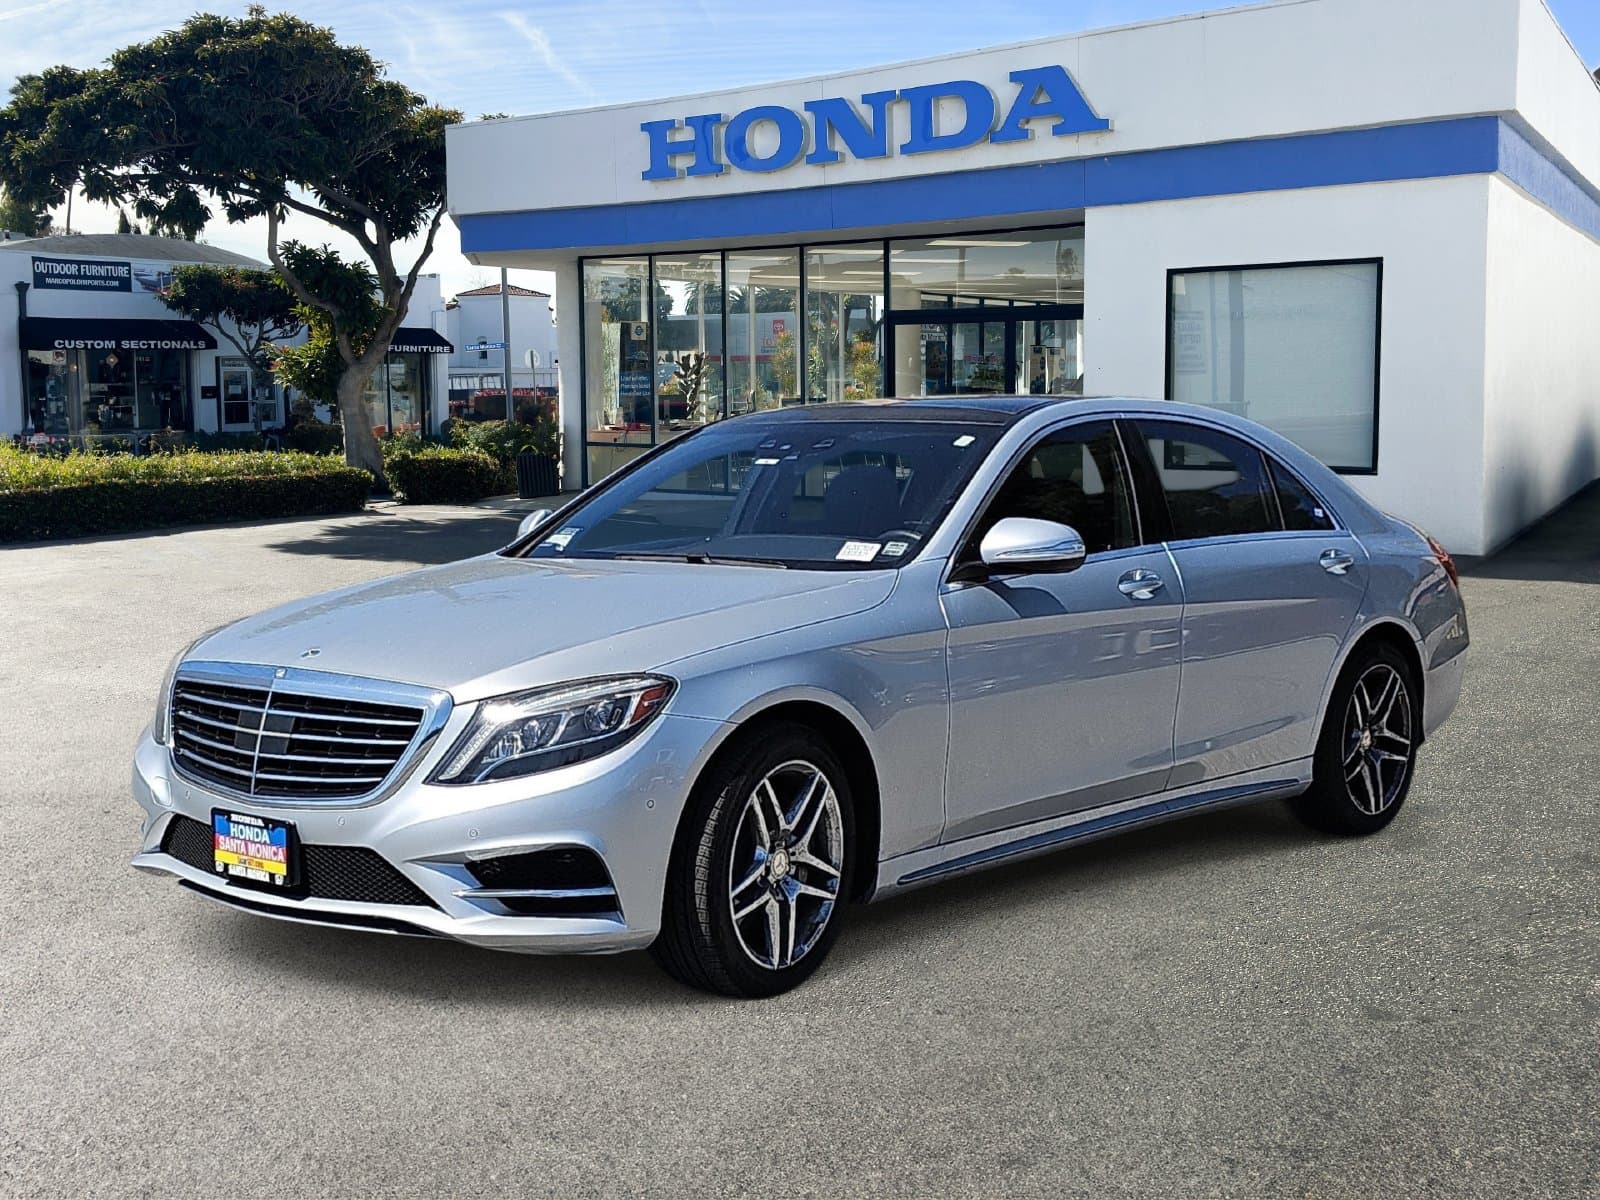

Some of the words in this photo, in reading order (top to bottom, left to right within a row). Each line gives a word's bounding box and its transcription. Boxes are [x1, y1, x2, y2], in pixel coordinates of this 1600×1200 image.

[640, 64, 1113, 181] HONDA
[34, 261, 79, 275] OUTDOOR
[80, 264, 130, 278] FURNITURE
[54, 339, 116, 349] CUSTOM
[121, 340, 206, 349] SECTIONALS
[388, 344, 451, 353] FURNITURE
[230, 823, 271, 844] HONDA
[219, 835, 246, 856] SANTA
[247, 840, 285, 862] MONICA
